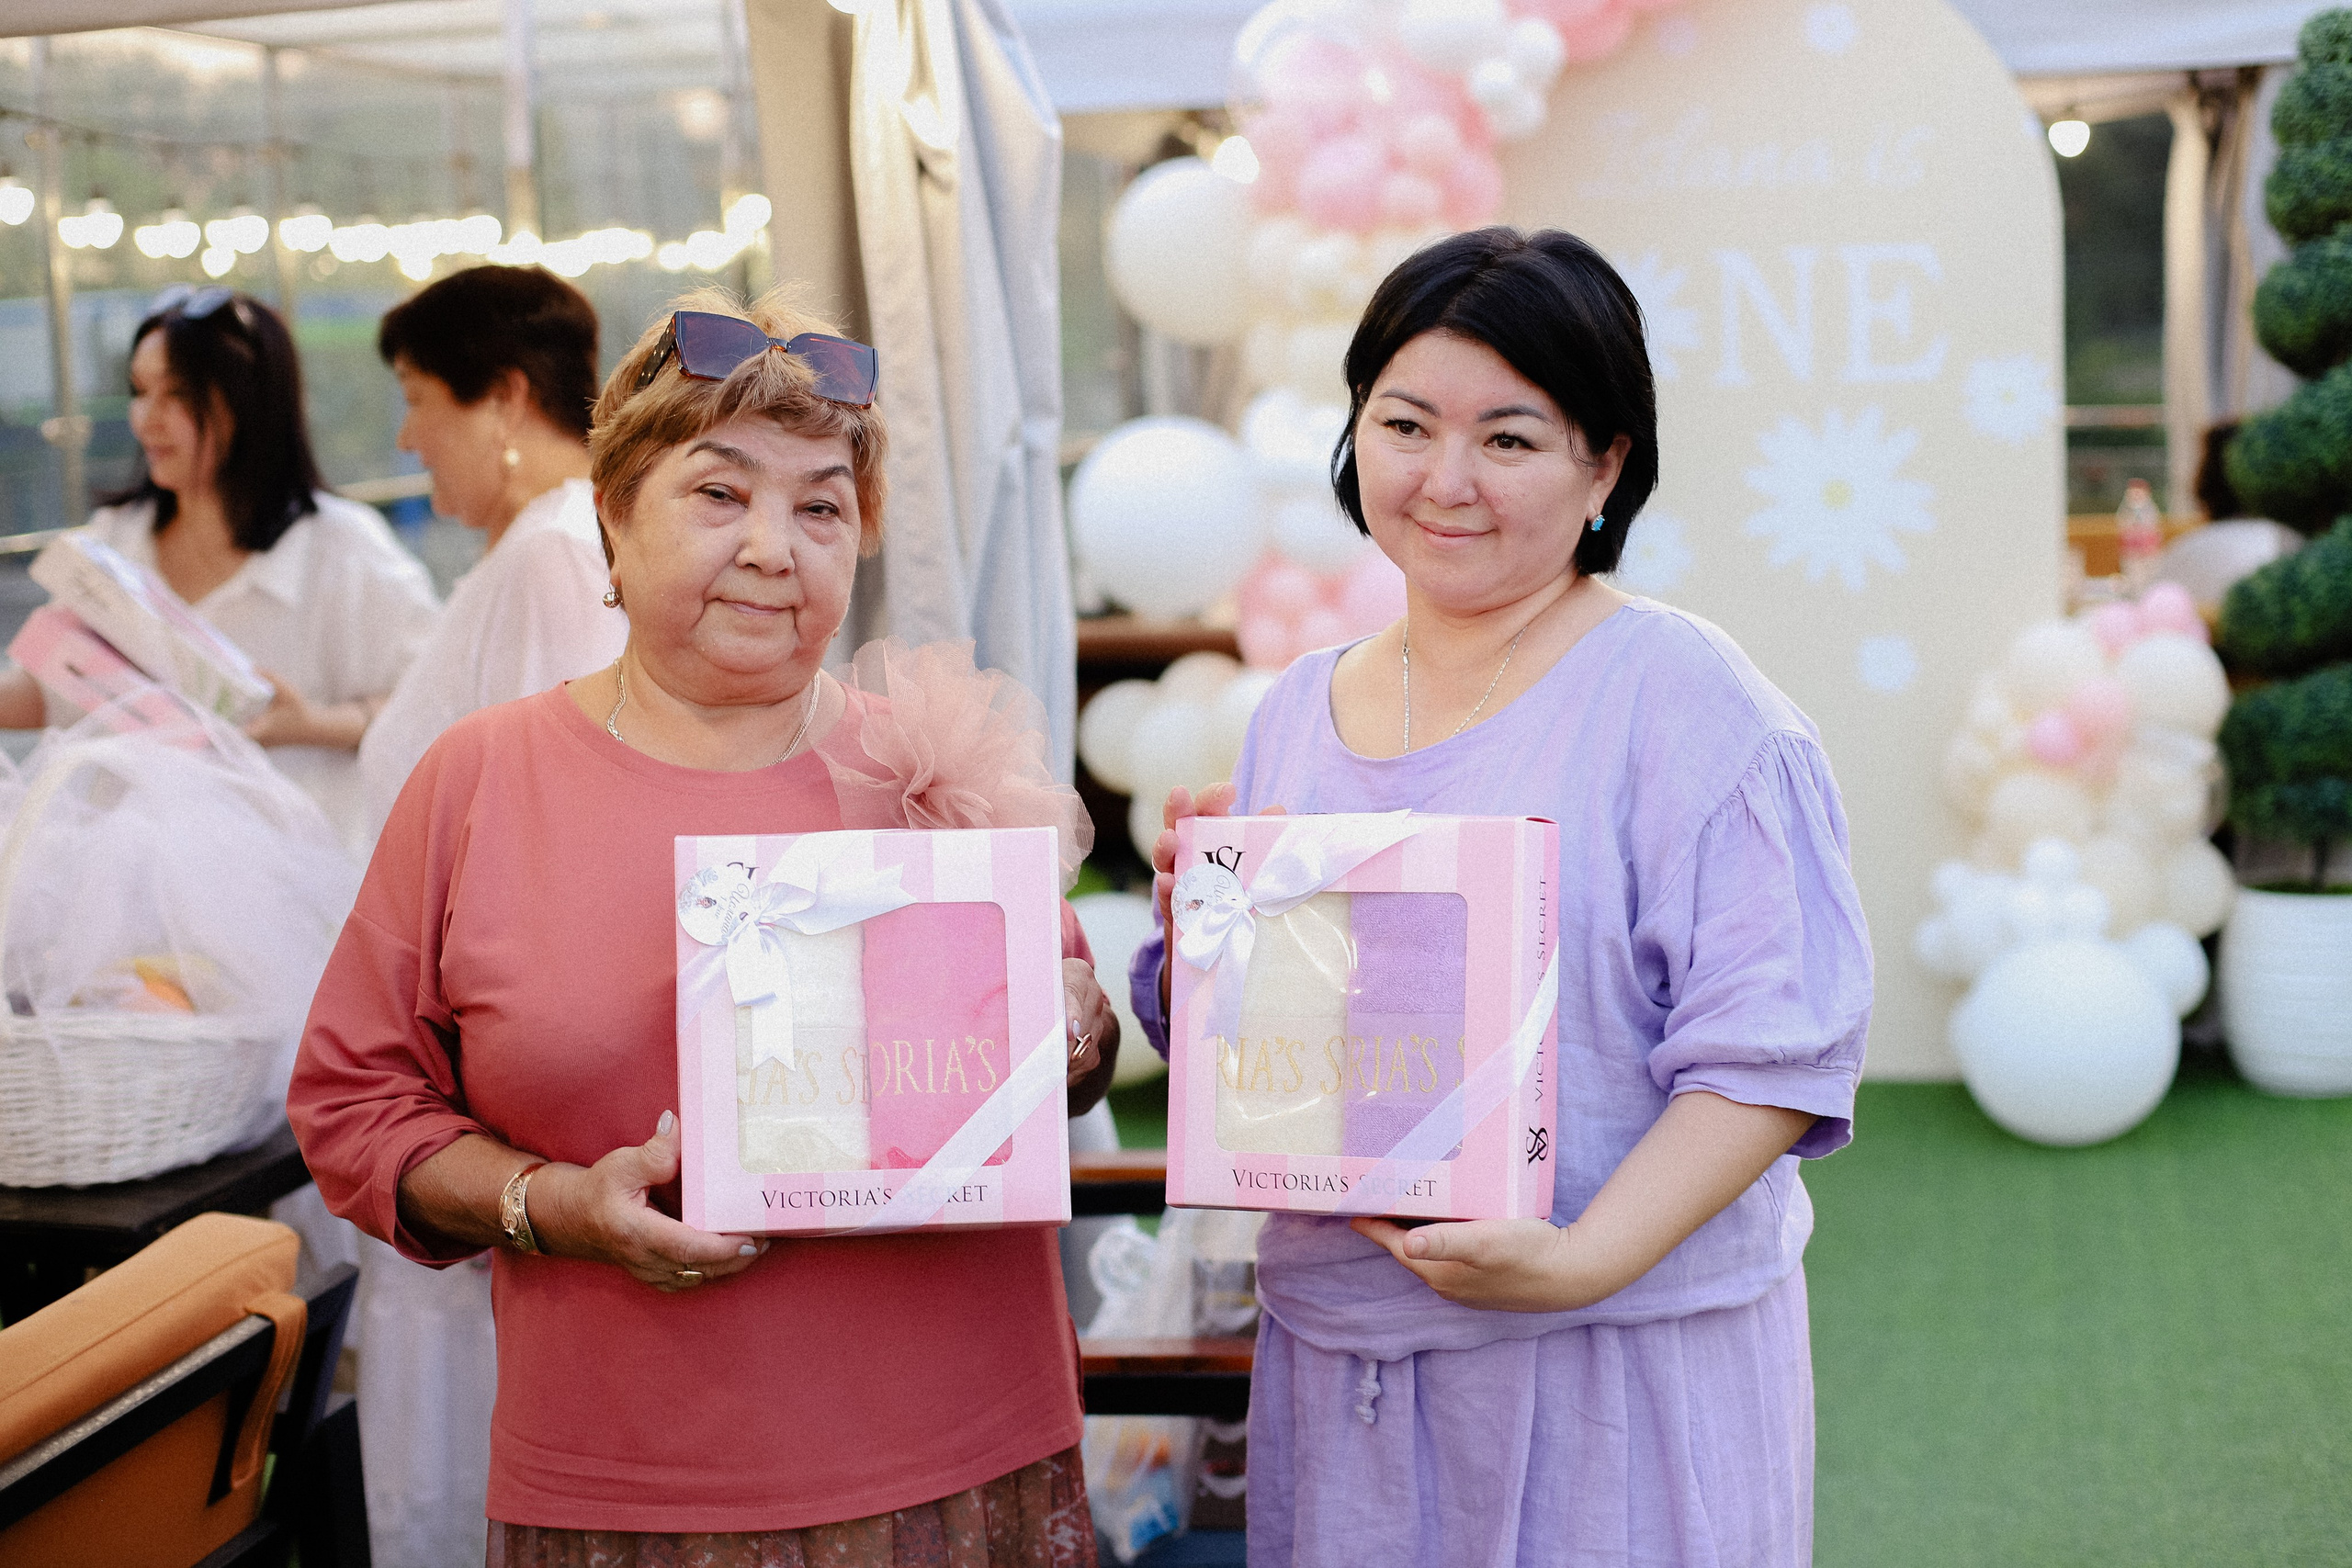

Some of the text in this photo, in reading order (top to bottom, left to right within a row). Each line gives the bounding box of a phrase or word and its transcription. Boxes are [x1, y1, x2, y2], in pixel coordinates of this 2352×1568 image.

[1536, 875, 1546, 960] SECRET
[1231, 1168, 1350, 1193] VICTORIA'S
[761, 1187, 892, 1210] VICTORIA'S
